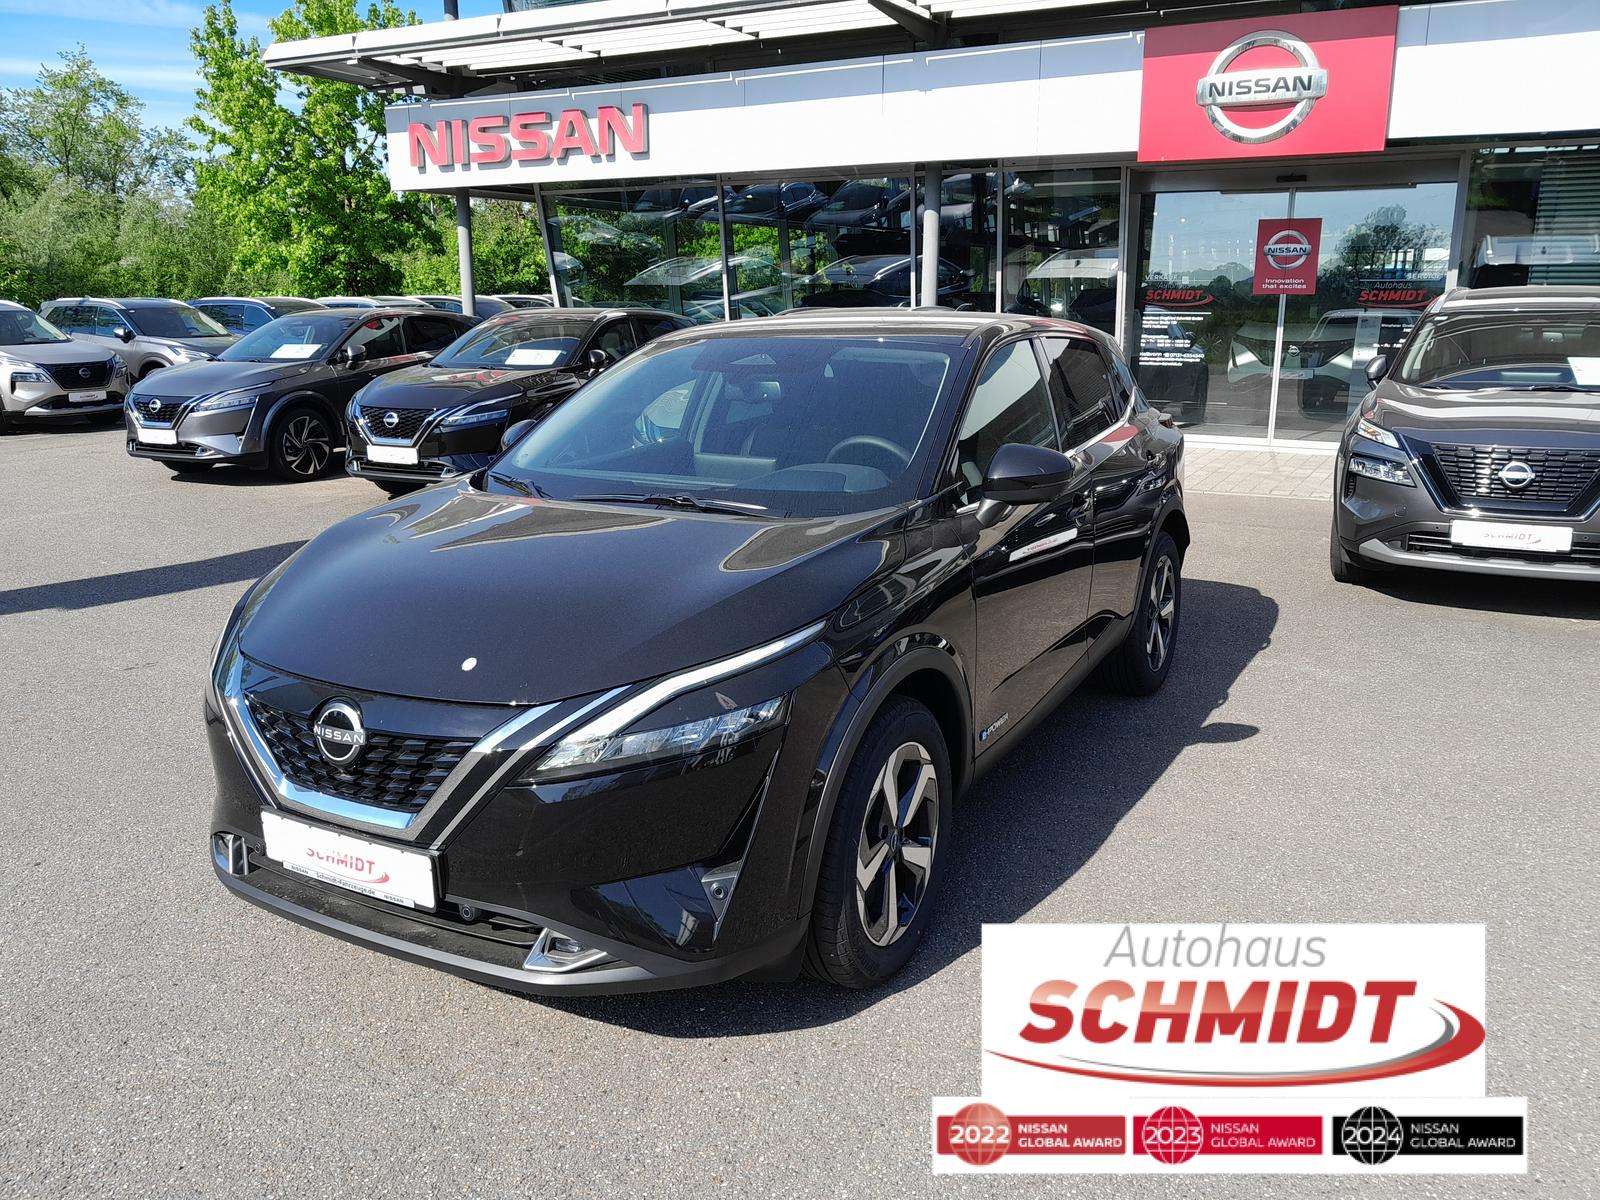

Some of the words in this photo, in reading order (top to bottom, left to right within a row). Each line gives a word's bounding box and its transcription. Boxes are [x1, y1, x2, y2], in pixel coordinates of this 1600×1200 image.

[1208, 74, 1313, 98] NISSAN
[408, 103, 646, 169] NISSAN
[1267, 246, 1307, 254] NISSAN
[1147, 289, 1204, 300] SCHMIDT
[1360, 290, 1427, 301] SCHMIDT
[313, 723, 364, 743] NISSAN
